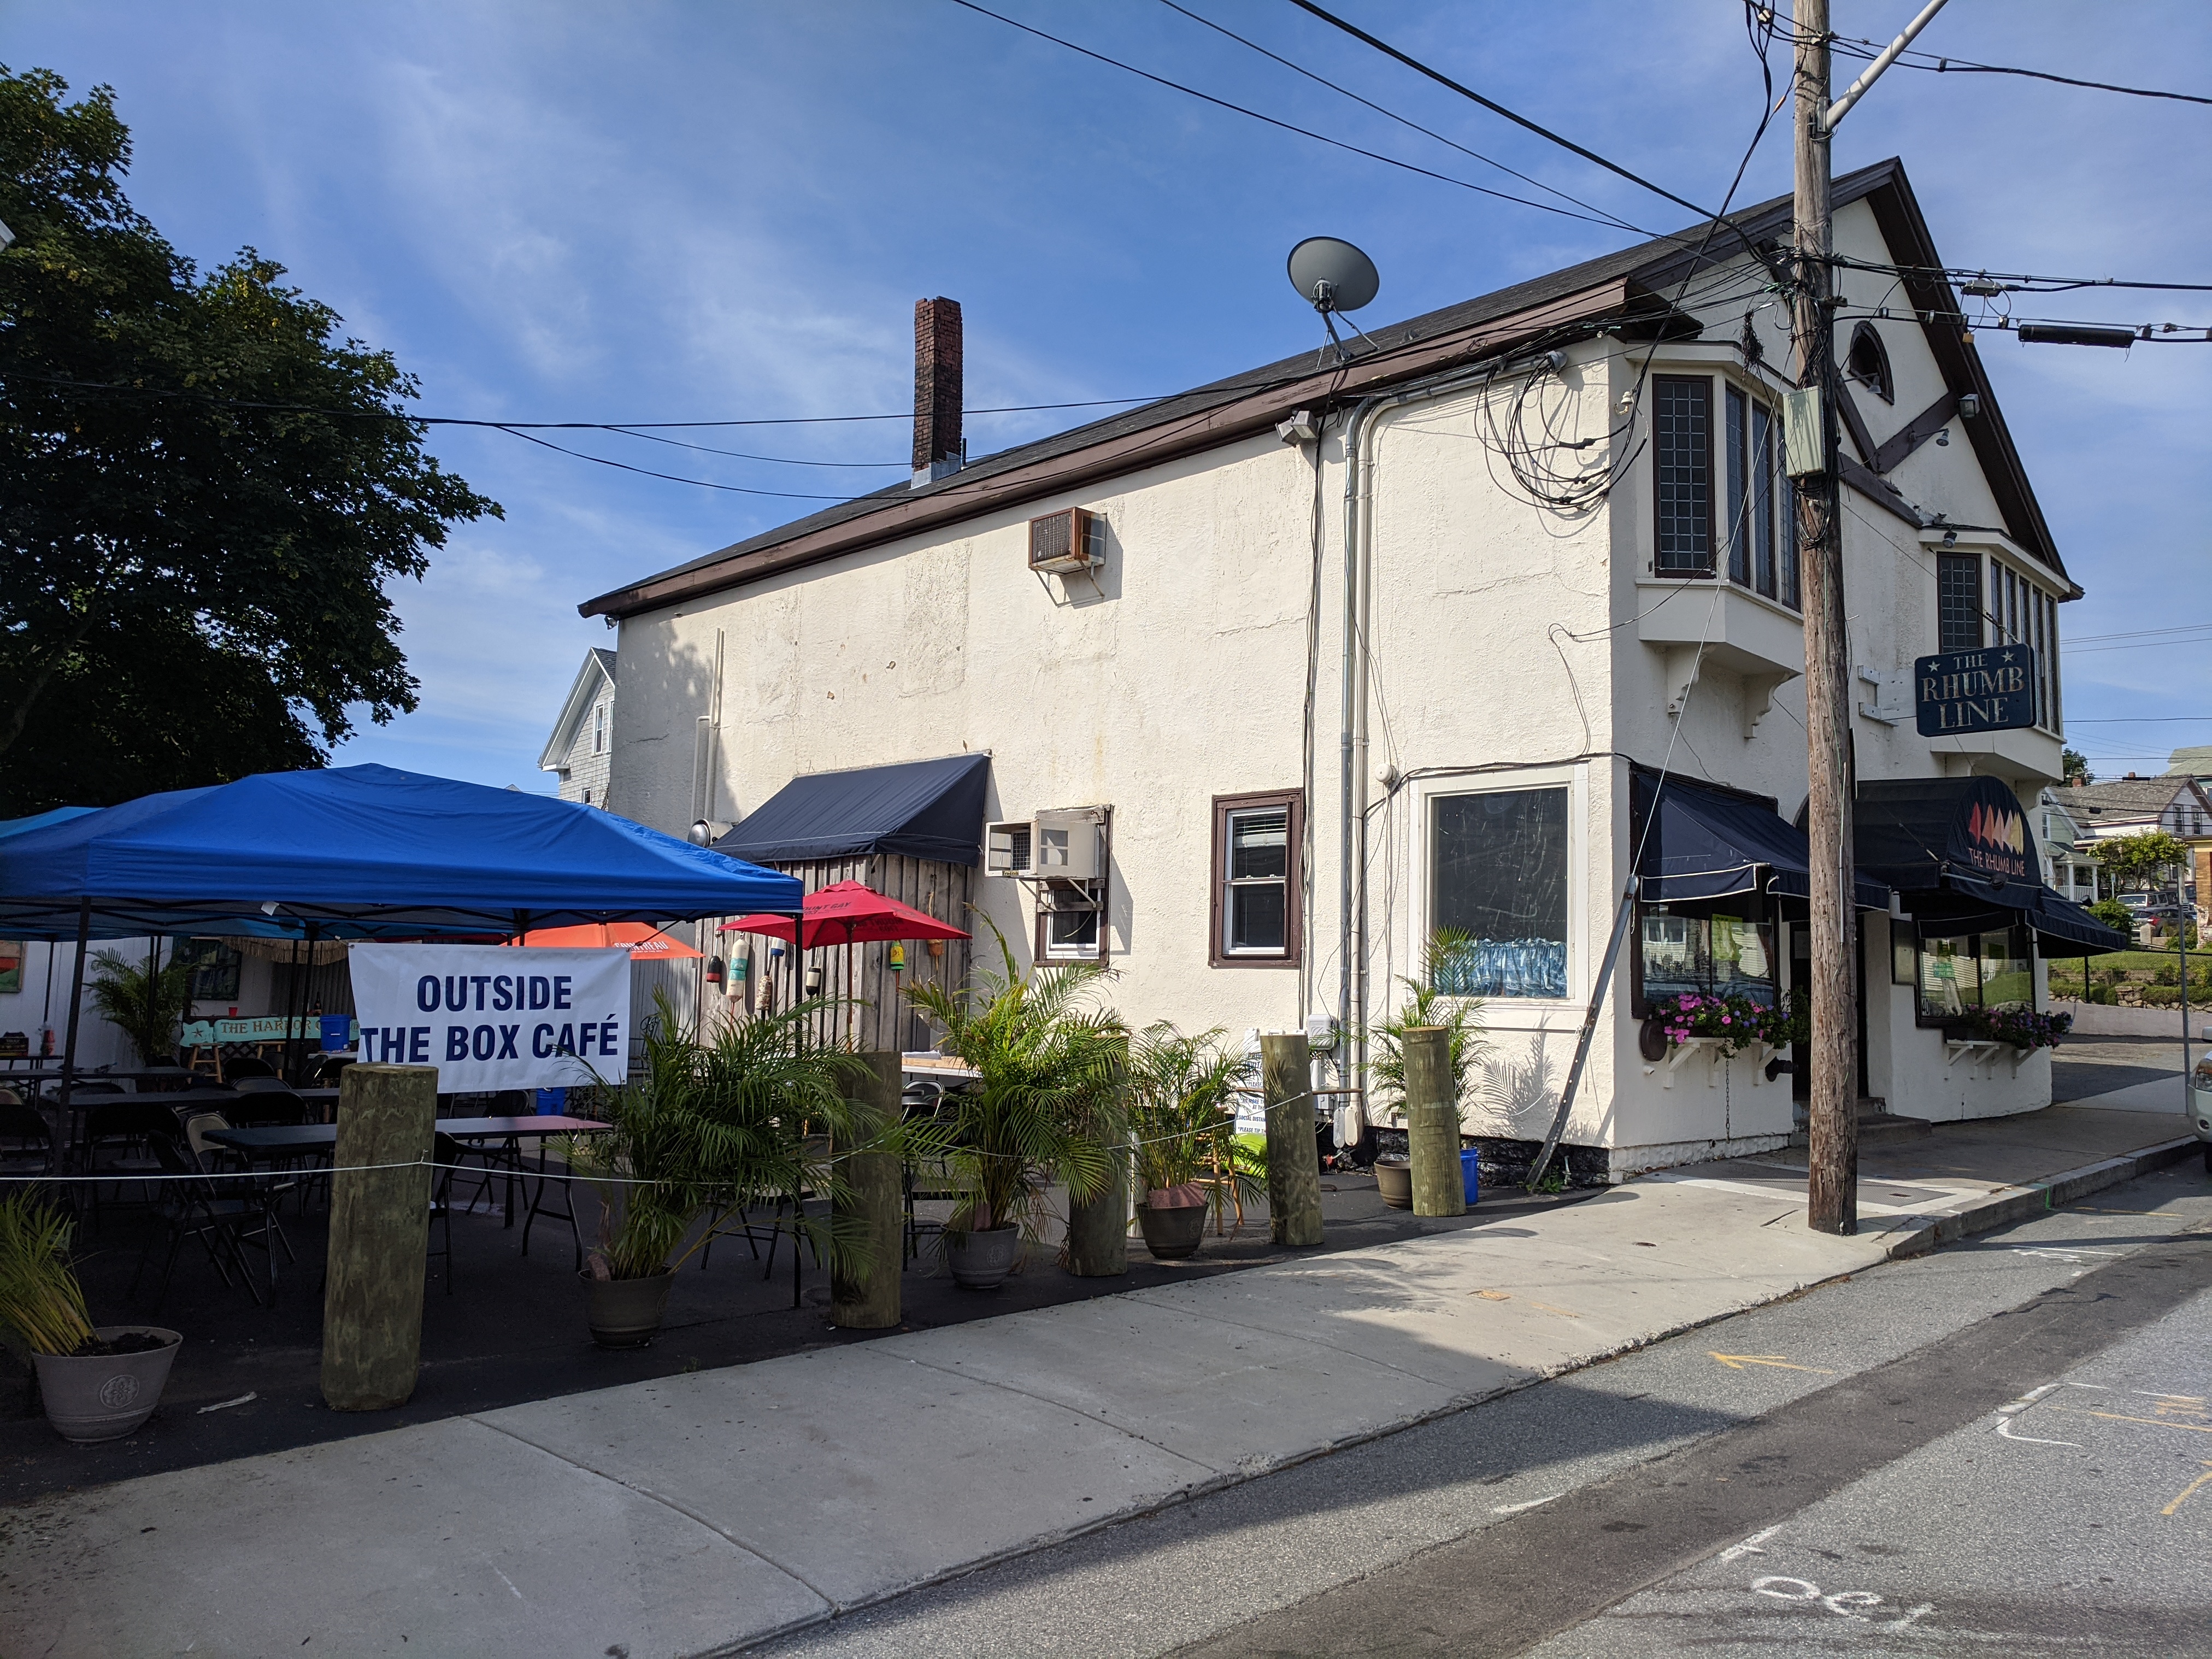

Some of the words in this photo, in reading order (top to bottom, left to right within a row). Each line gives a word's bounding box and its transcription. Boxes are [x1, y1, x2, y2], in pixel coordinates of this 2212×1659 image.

[1954, 653, 1988, 670] THE
[1921, 667, 2025, 702] RHUMB
[1938, 697, 2009, 729] LINE
[1968, 848, 1984, 868] THE
[1985, 852, 2010, 874] RHUMB
[2011, 859, 2025, 876] LINE
[417, 975, 572, 1013] OUTSIDE
[220, 1022, 248, 1033] THE
[360, 1026, 431, 1064] THE
[445, 1024, 520, 1062] BOX
[532, 1014, 619, 1059] CAFÉ
